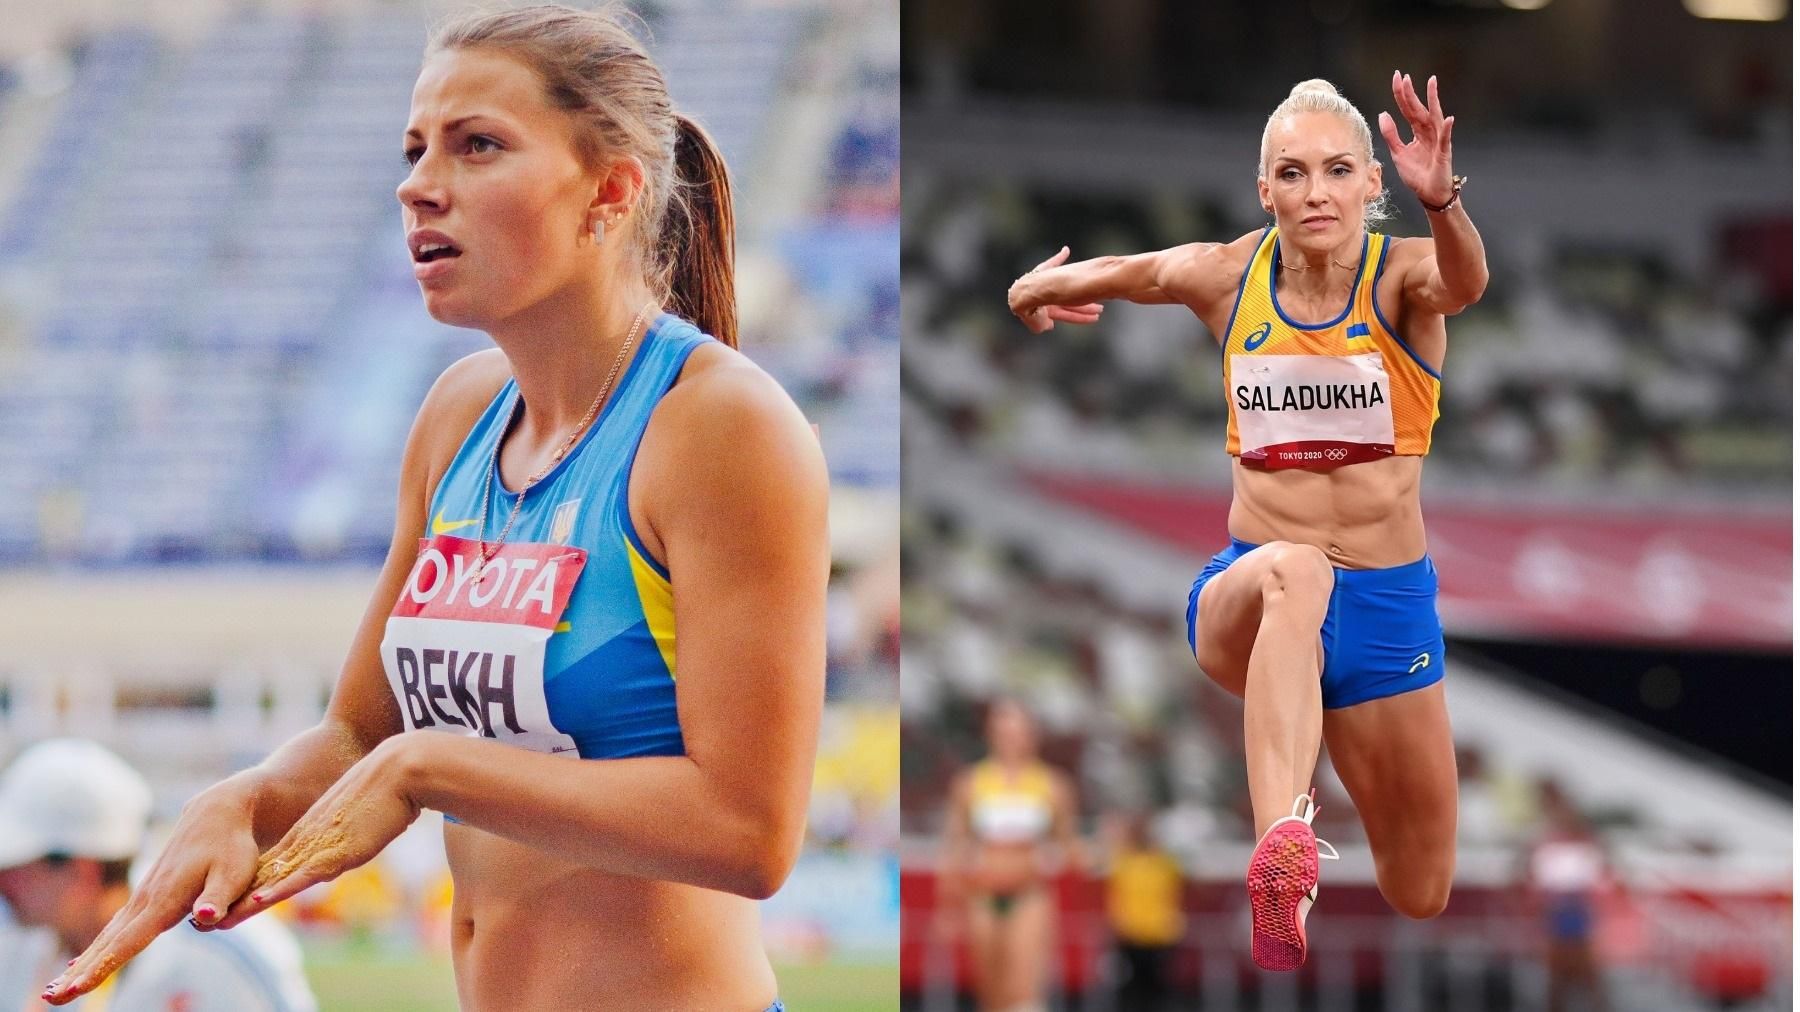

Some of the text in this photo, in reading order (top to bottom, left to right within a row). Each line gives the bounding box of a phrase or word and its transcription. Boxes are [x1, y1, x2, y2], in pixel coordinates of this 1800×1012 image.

[1237, 381, 1384, 411] SALADUKHA
[1279, 451, 1322, 460] TOKYO 2020
[396, 647, 528, 738] BEKH
